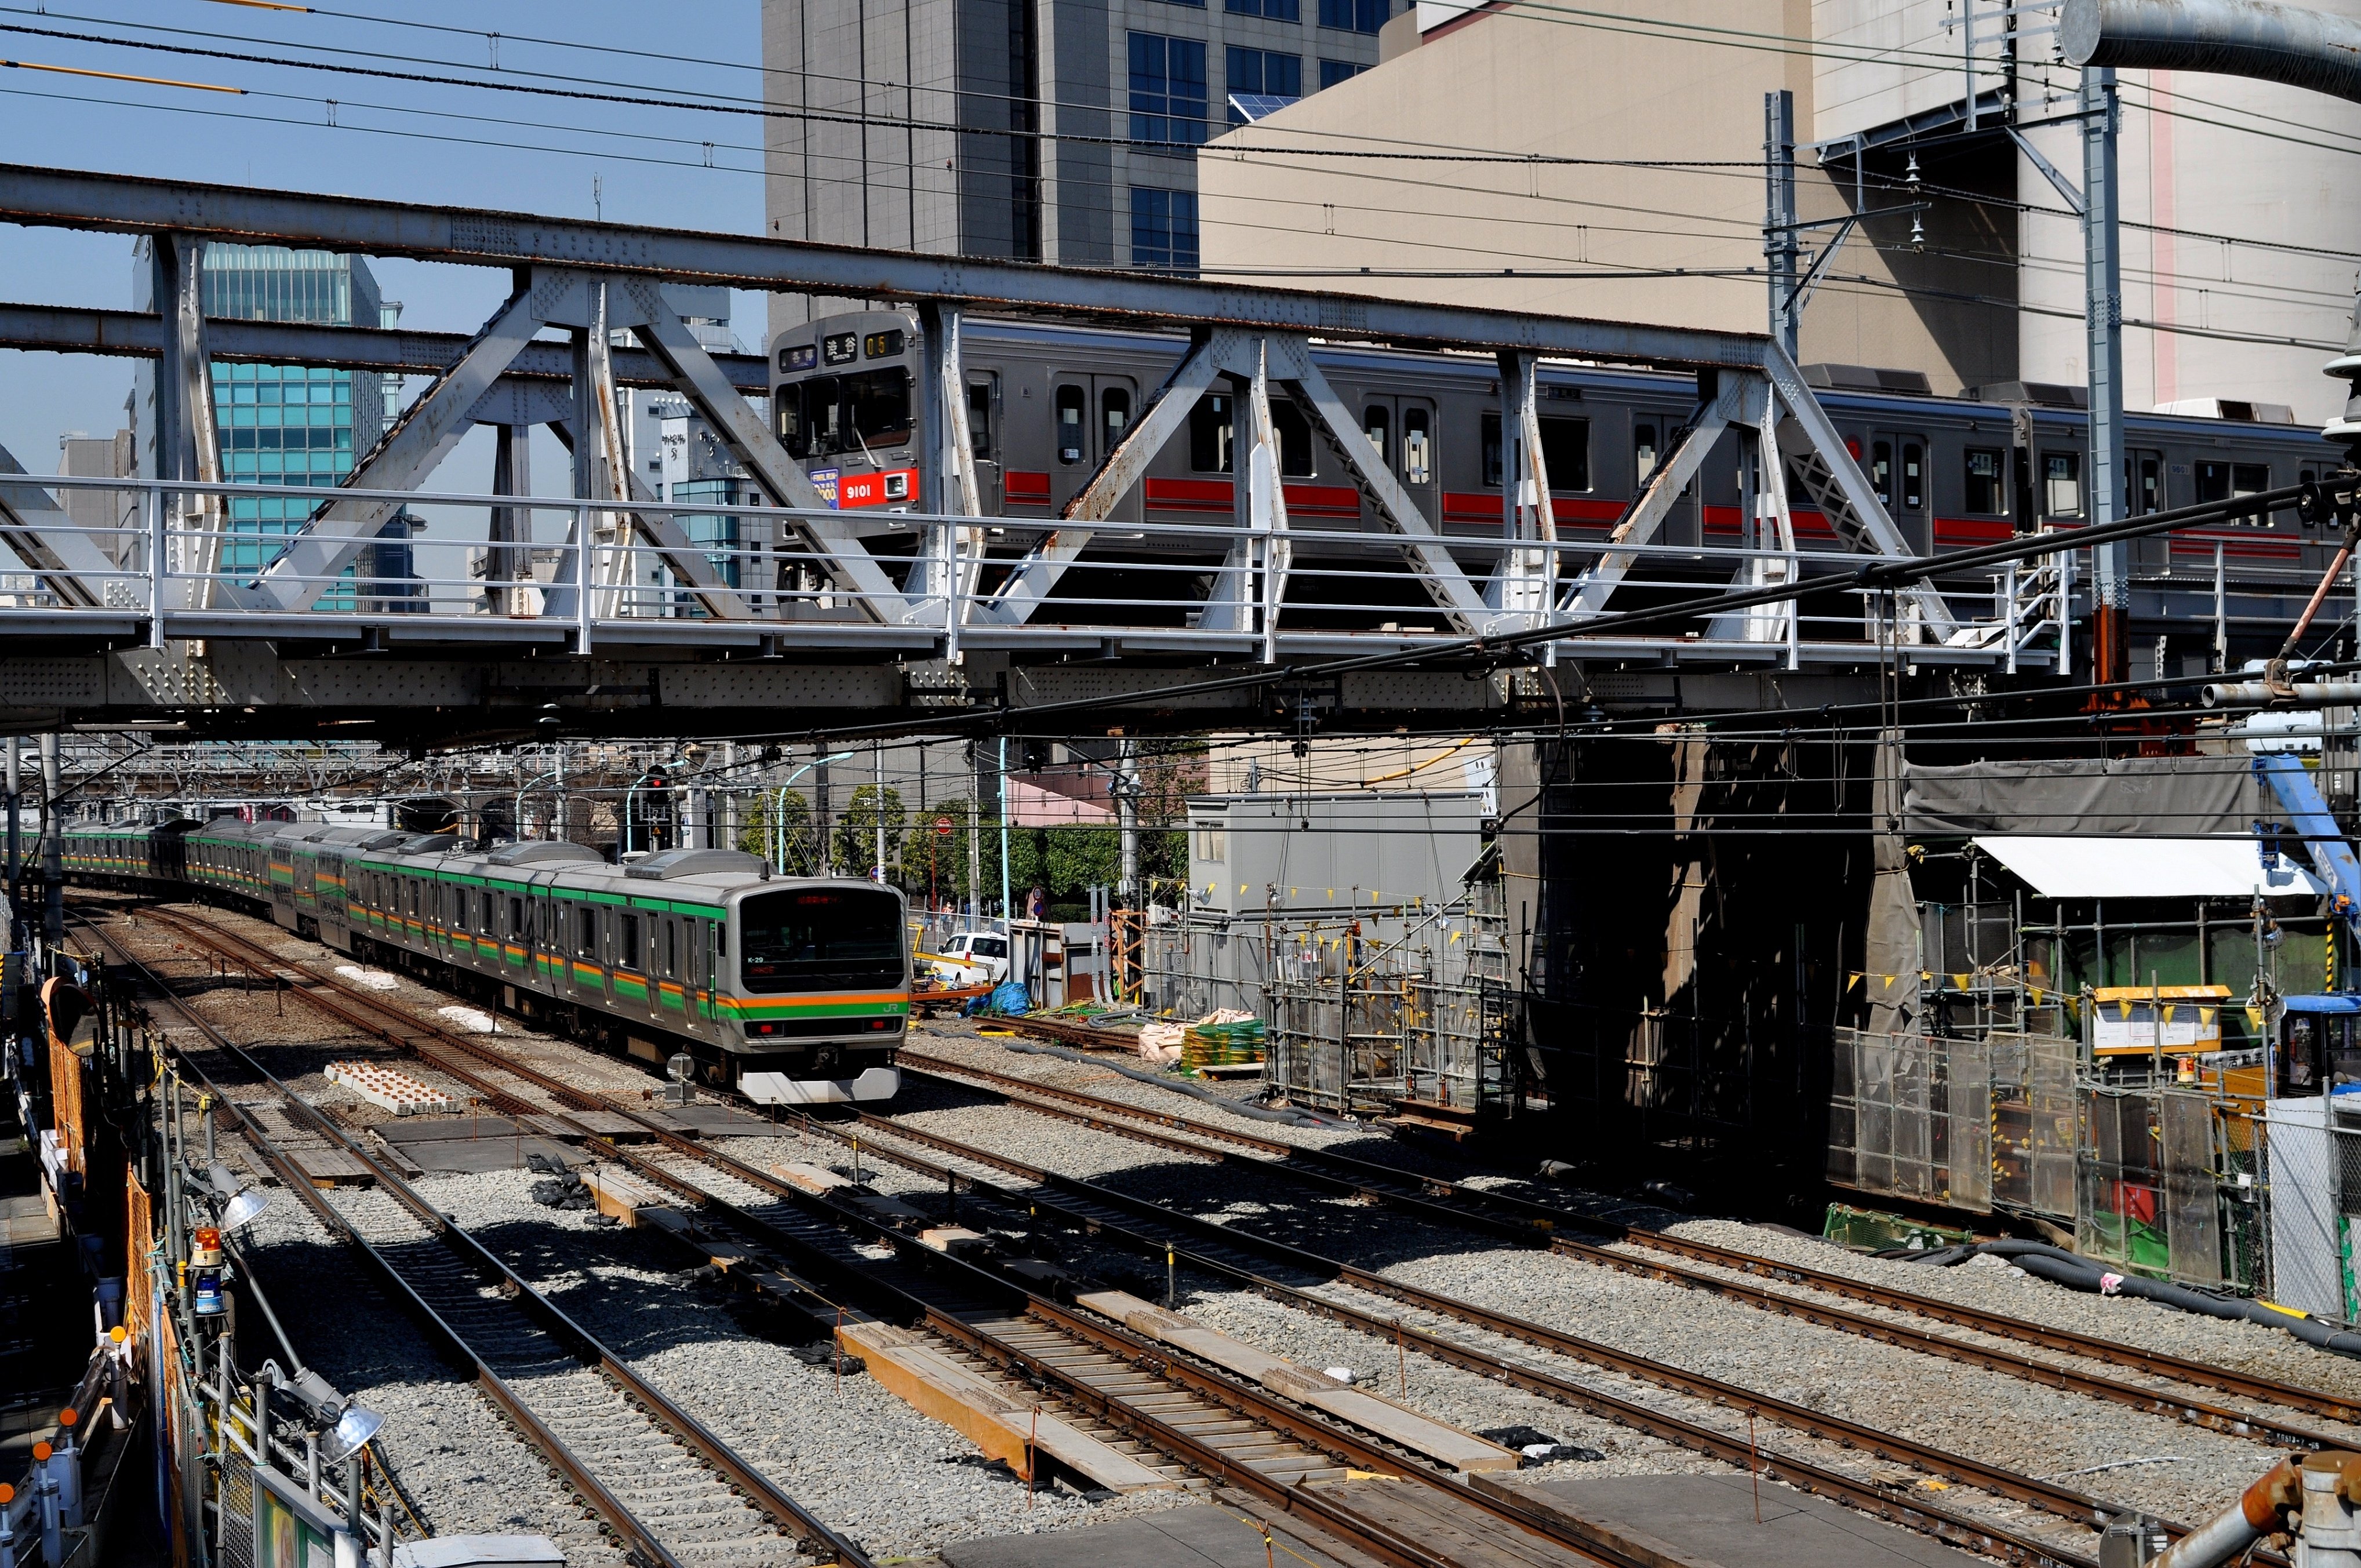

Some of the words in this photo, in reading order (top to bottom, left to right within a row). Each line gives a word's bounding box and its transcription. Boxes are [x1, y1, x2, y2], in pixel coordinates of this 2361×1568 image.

[827, 337, 856, 356] 渋谷
[867, 336, 885, 355] 05
[847, 484, 871, 499] 9101
[883, 1003, 898, 1012] JR
